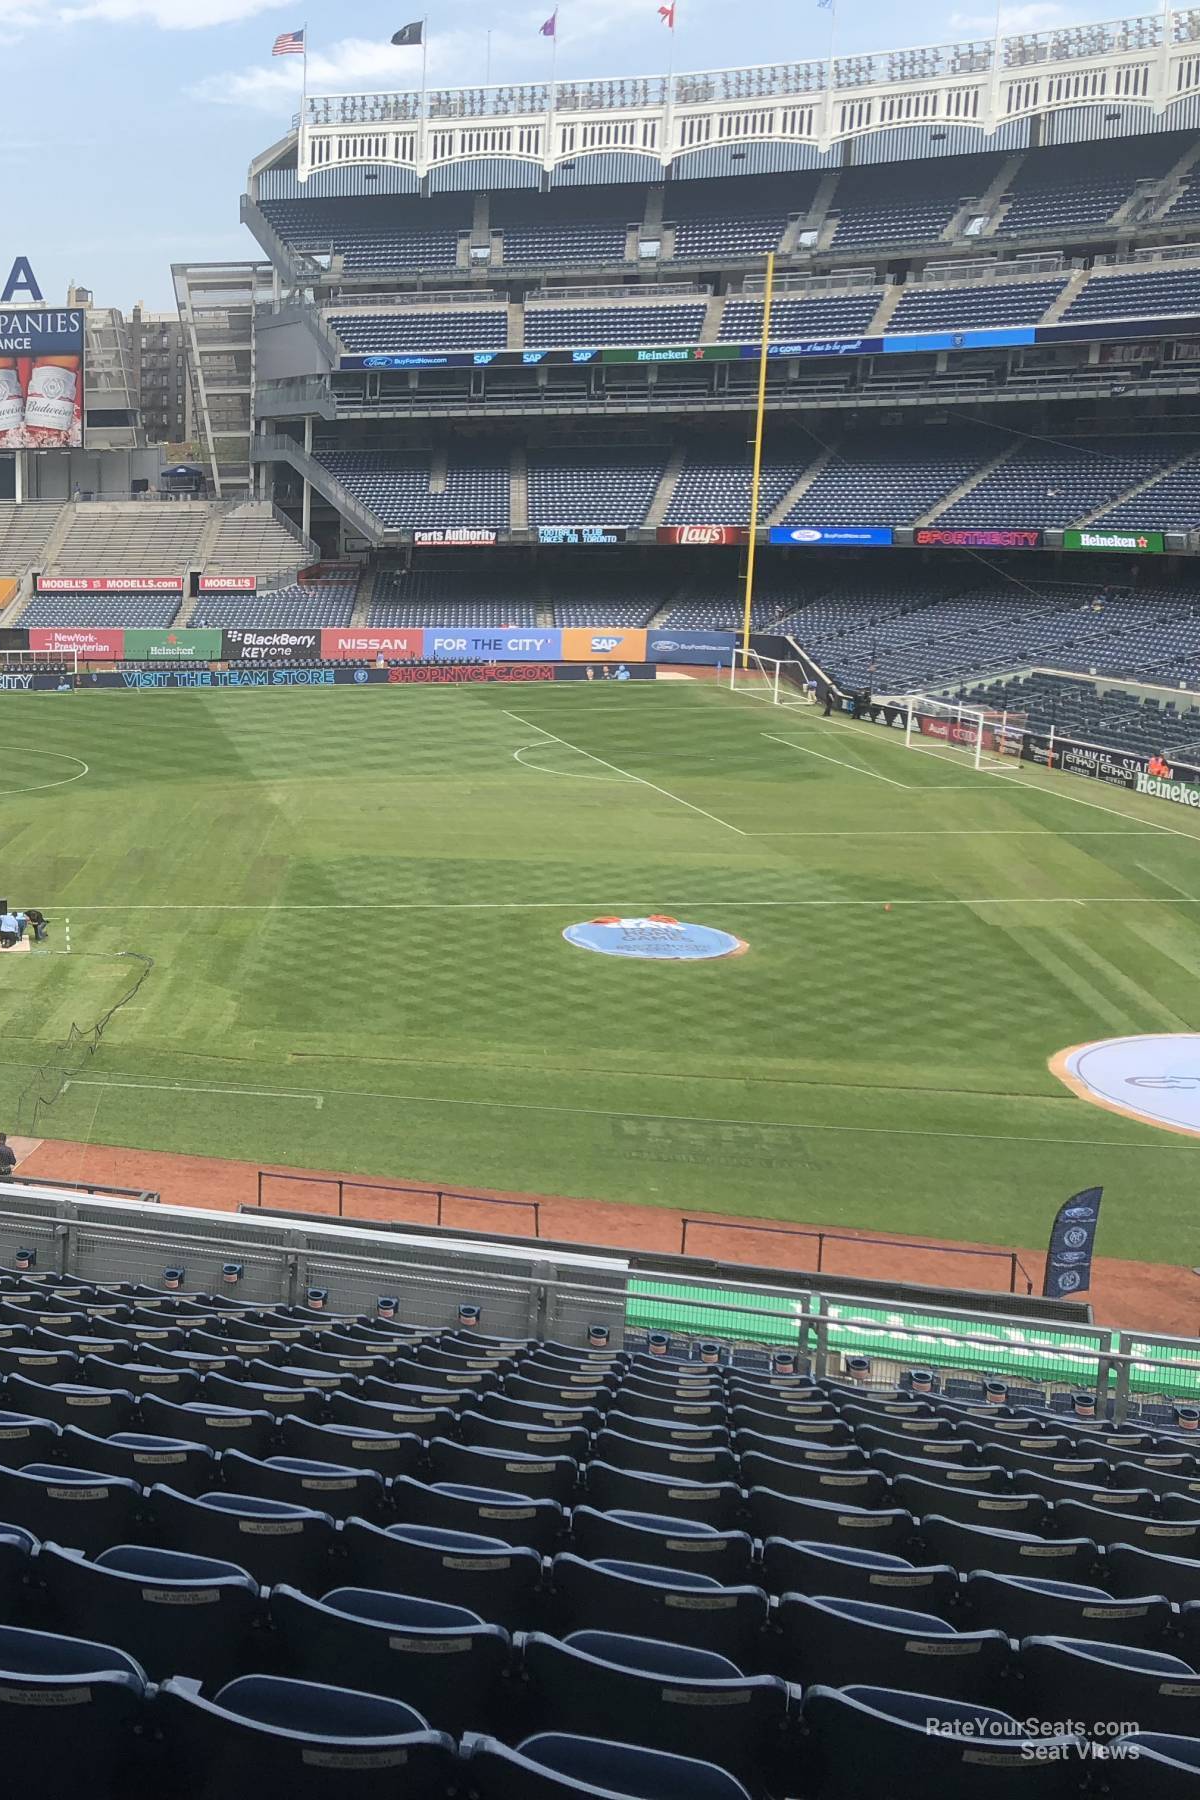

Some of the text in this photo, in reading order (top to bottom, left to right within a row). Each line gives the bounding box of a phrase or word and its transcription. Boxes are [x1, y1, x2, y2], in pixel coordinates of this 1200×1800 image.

[394, 357, 447, 366] BuyFordNow.com
[474, 353, 491, 363] SAP
[523, 353, 541, 362] SAP
[573, 352, 591, 361] SAP
[638, 350, 688, 361] Heineken
[414, 529, 496, 542] Parts Authority
[681, 526, 721, 544] Lay's
[917, 531, 1038, 546] #FORTHECITY
[1080, 533, 1136, 548] Heineken
[42, 578, 177, 588] MODELL'S MODELLS.com
[204, 578, 250, 588] MODELL'S
[54, 633, 97, 642] NewYork-
[243, 632, 312, 647] BlackBerry
[54, 642, 109, 654] Presbyterian
[150, 645, 194, 655] Heineken
[338, 639, 407, 650] NISSAN
[434, 638, 544, 651] FOR THE CITY
[591, 638, 617, 650] SAP
[123, 669, 334, 687] VISIT THE TEAM STORE
[388, 665, 554, 682] SHOP.NYCFC.COM
[1101, 766, 1132, 780] ETIHAD
